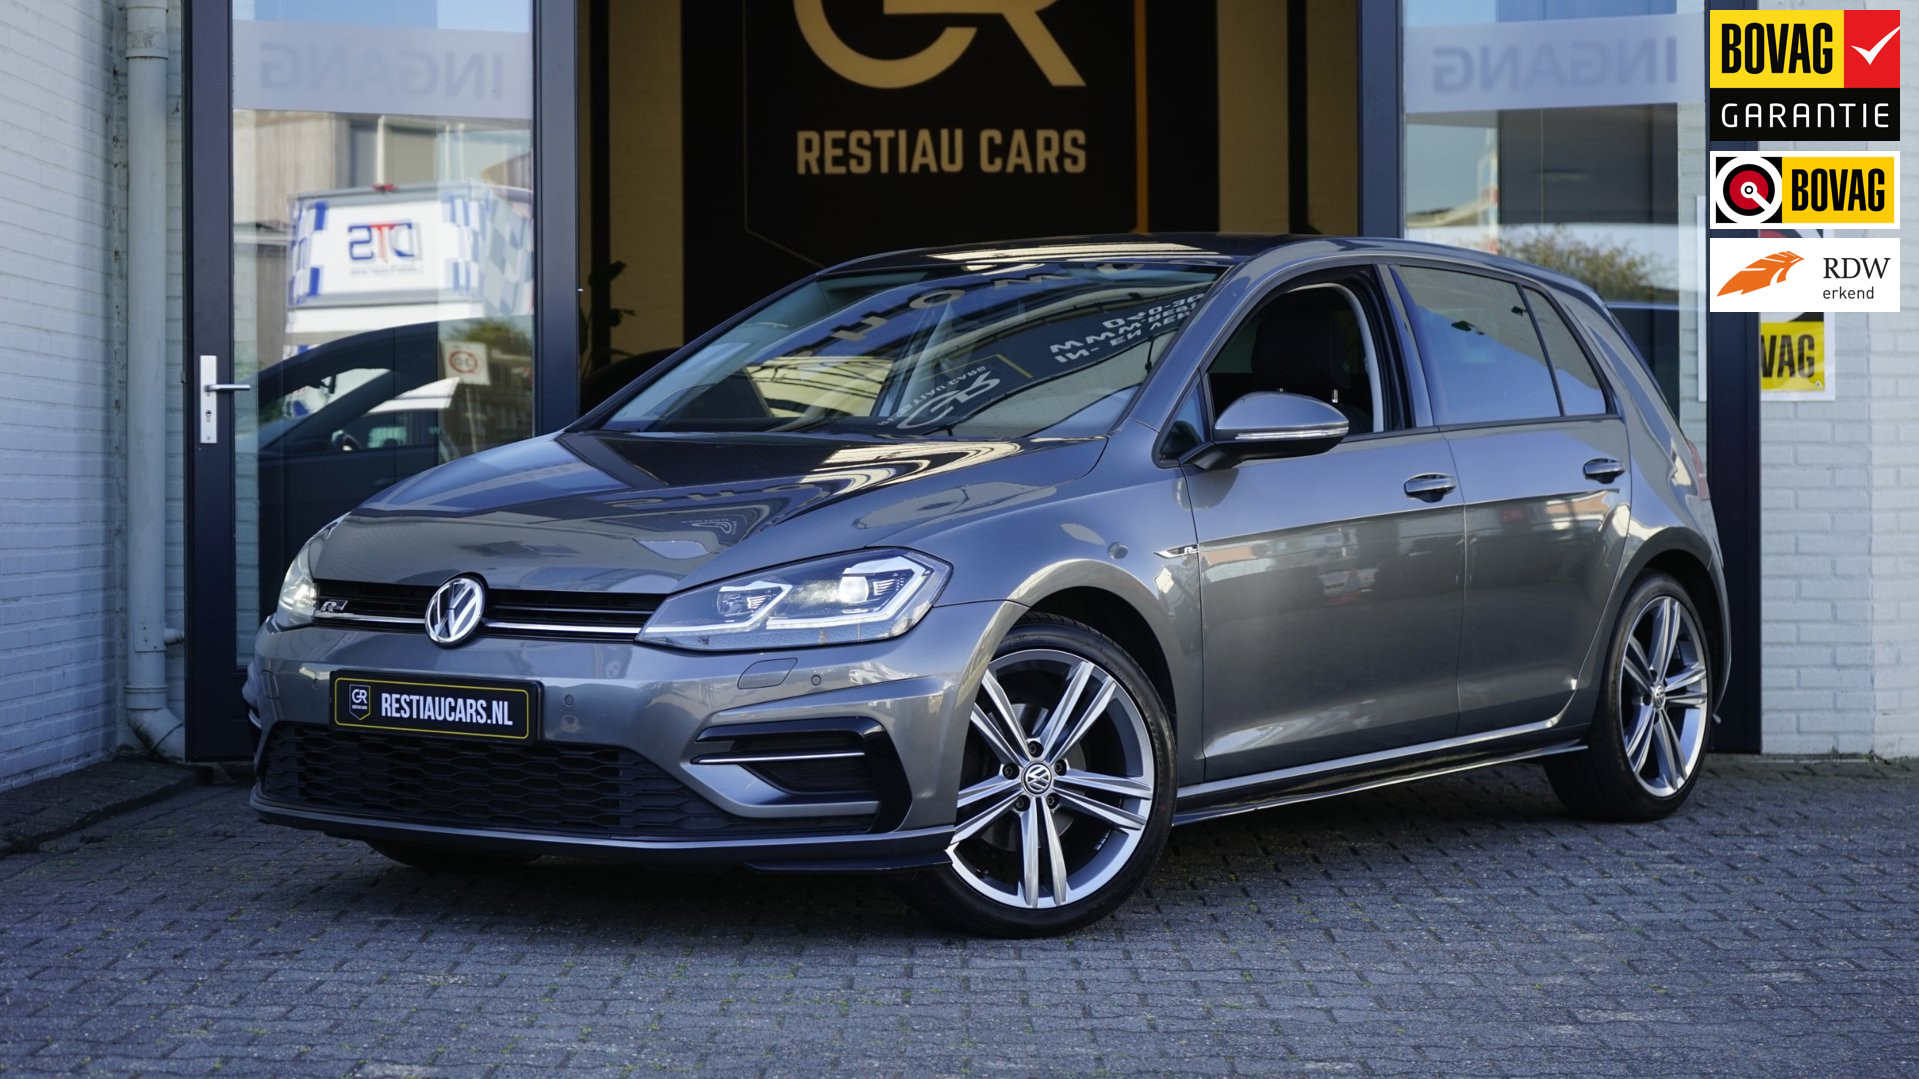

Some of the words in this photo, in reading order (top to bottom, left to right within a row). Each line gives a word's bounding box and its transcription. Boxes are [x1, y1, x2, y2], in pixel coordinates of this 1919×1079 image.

[796, 129, 963, 175] RESTIAU
[979, 129, 1087, 174] CARS
[1760, 334, 1815, 378] VAG
[381, 693, 513, 726] RESTIAUCARS.NL
